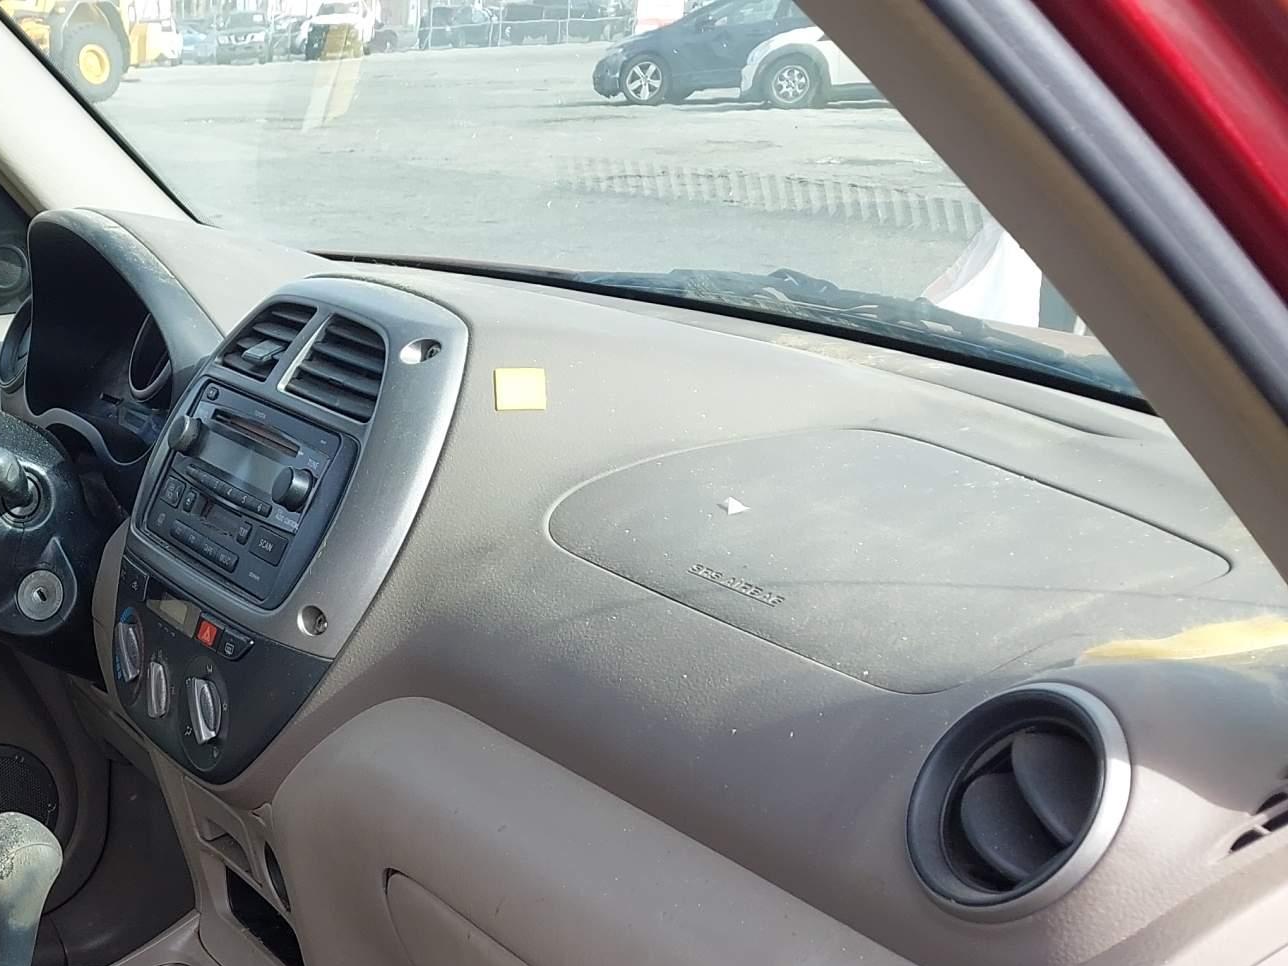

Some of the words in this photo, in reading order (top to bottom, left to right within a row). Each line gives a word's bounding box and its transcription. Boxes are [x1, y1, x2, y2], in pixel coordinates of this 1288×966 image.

[258, 538, 274, 552] SCAN
[691, 563, 723, 580] SRS
[726, 577, 786, 606] AIRBAG
